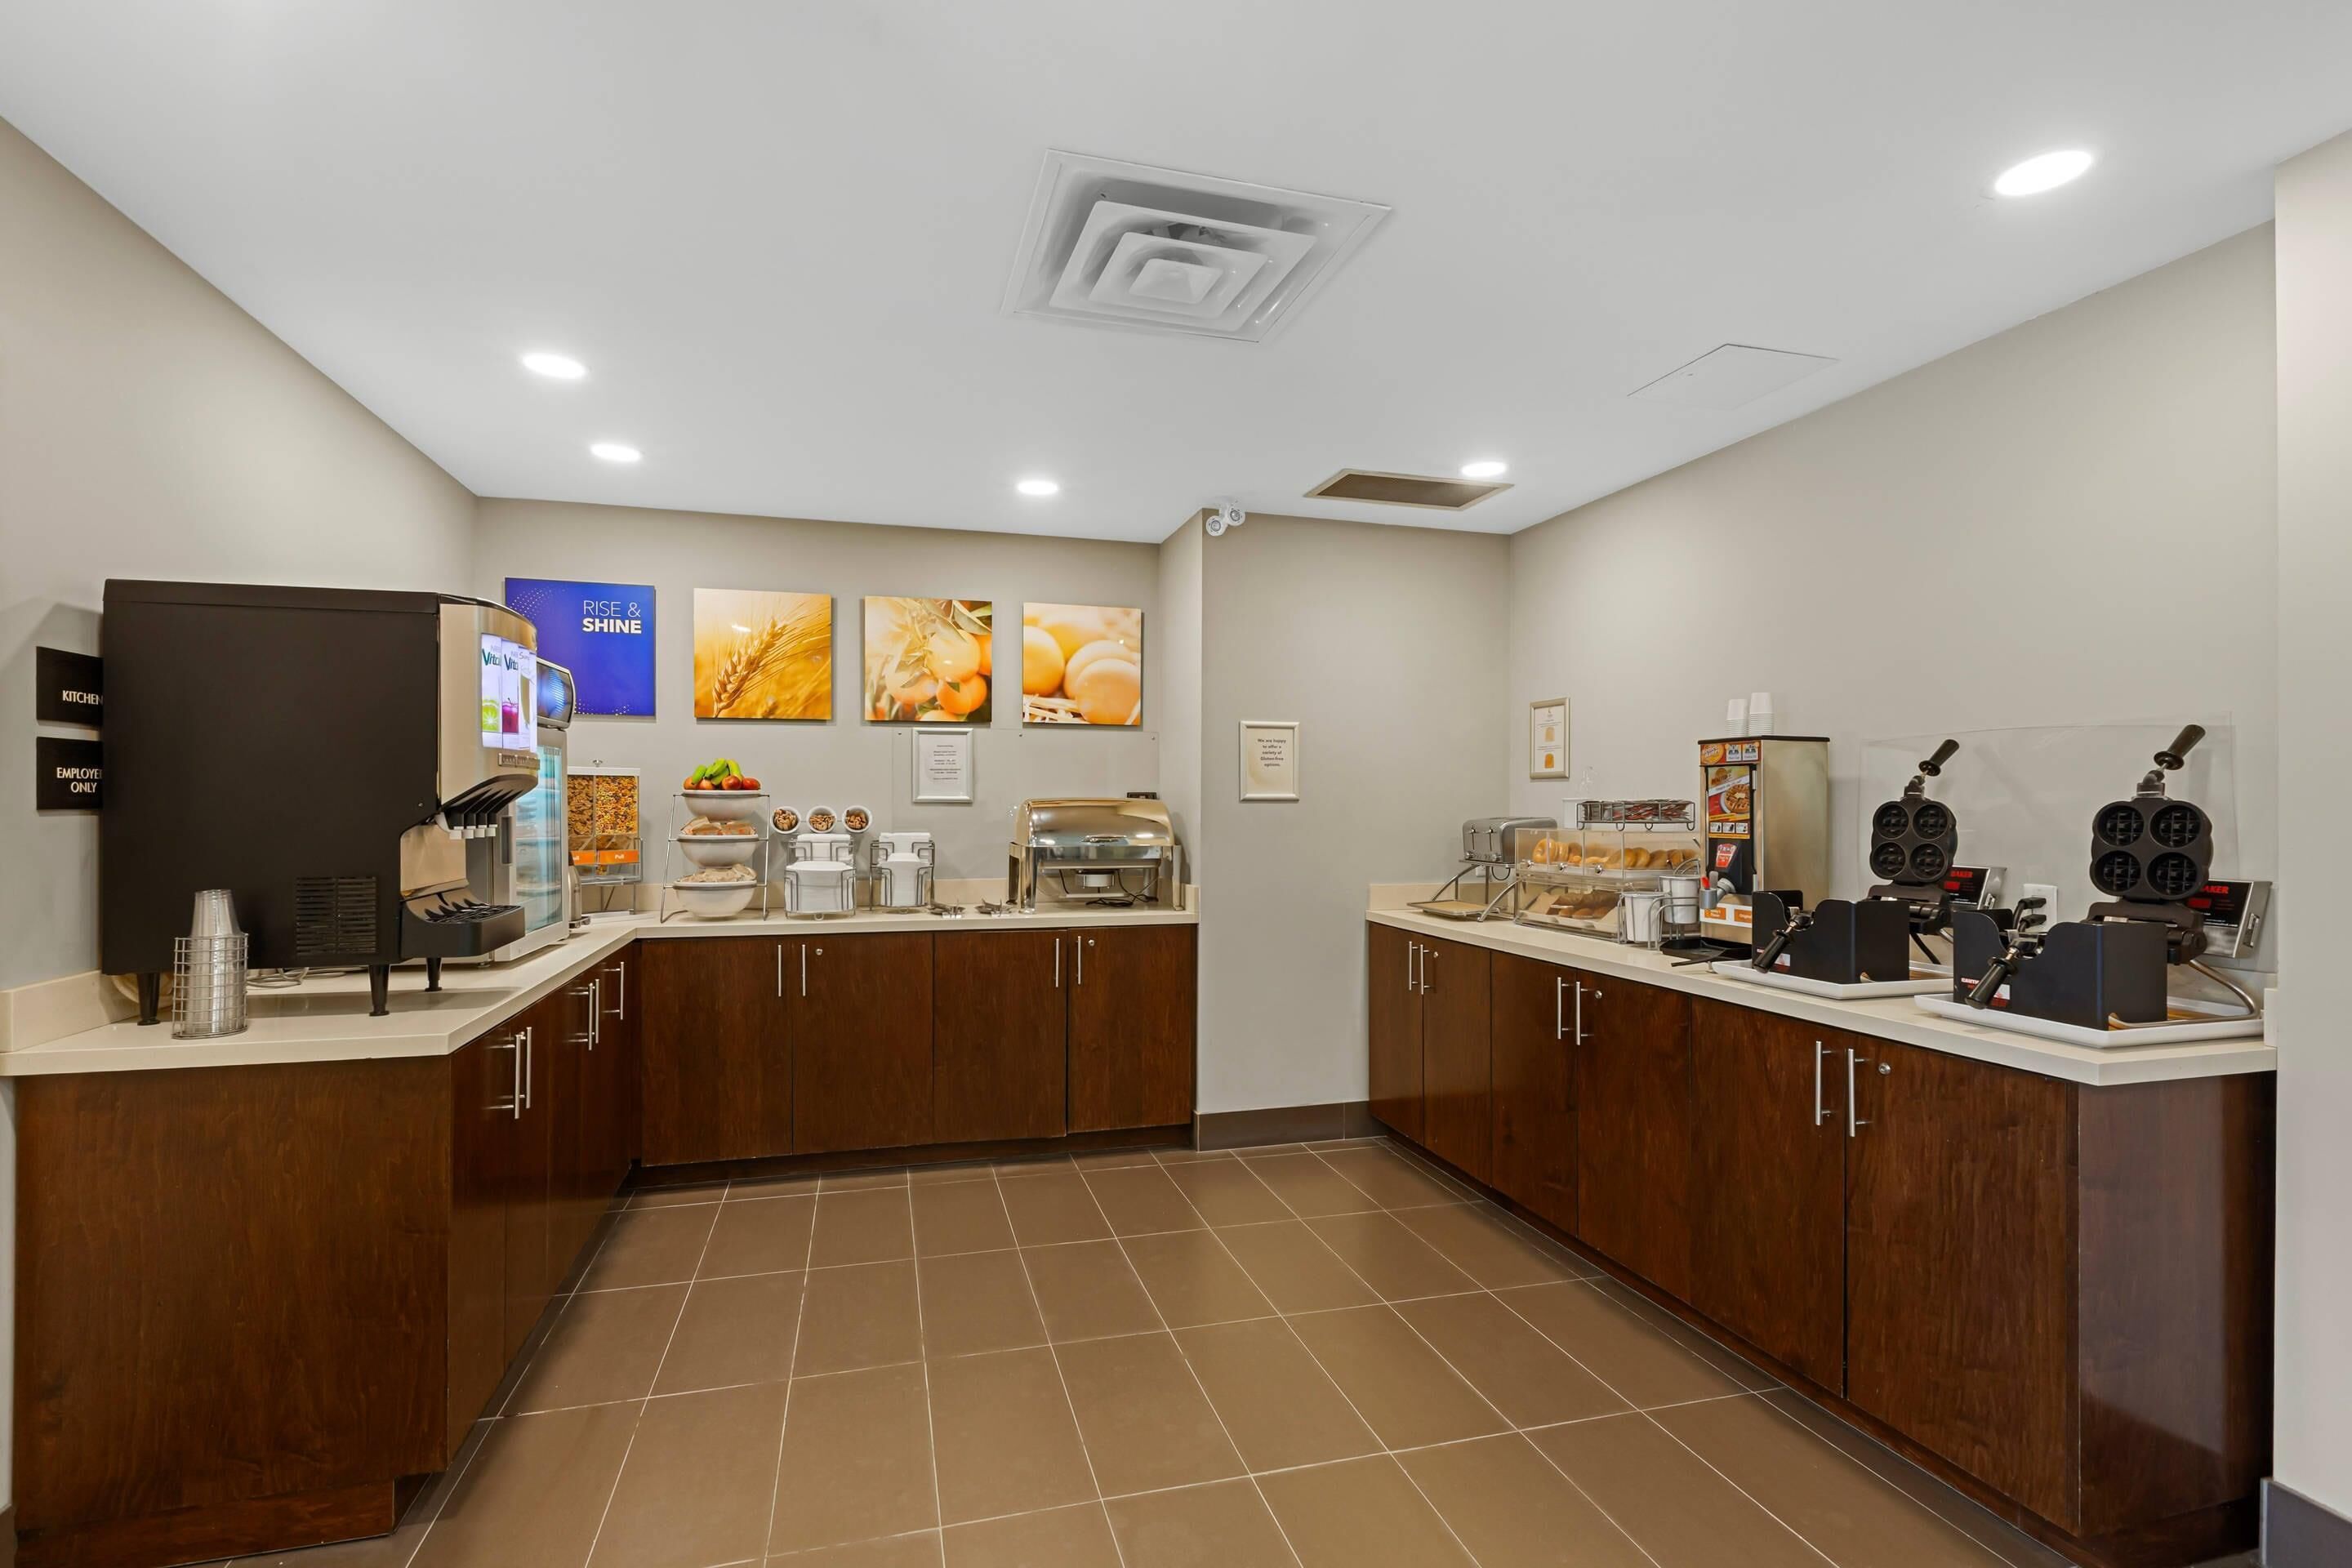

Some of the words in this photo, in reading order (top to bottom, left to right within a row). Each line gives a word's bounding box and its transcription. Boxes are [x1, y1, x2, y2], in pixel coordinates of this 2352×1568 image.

[583, 599, 621, 617] RISE
[627, 602, 641, 617] &
[582, 617, 642, 634] SHINE
[62, 690, 103, 706] KITCHEN
[70, 782, 97, 793] ONLY
[2200, 885, 2229, 893] AKER
